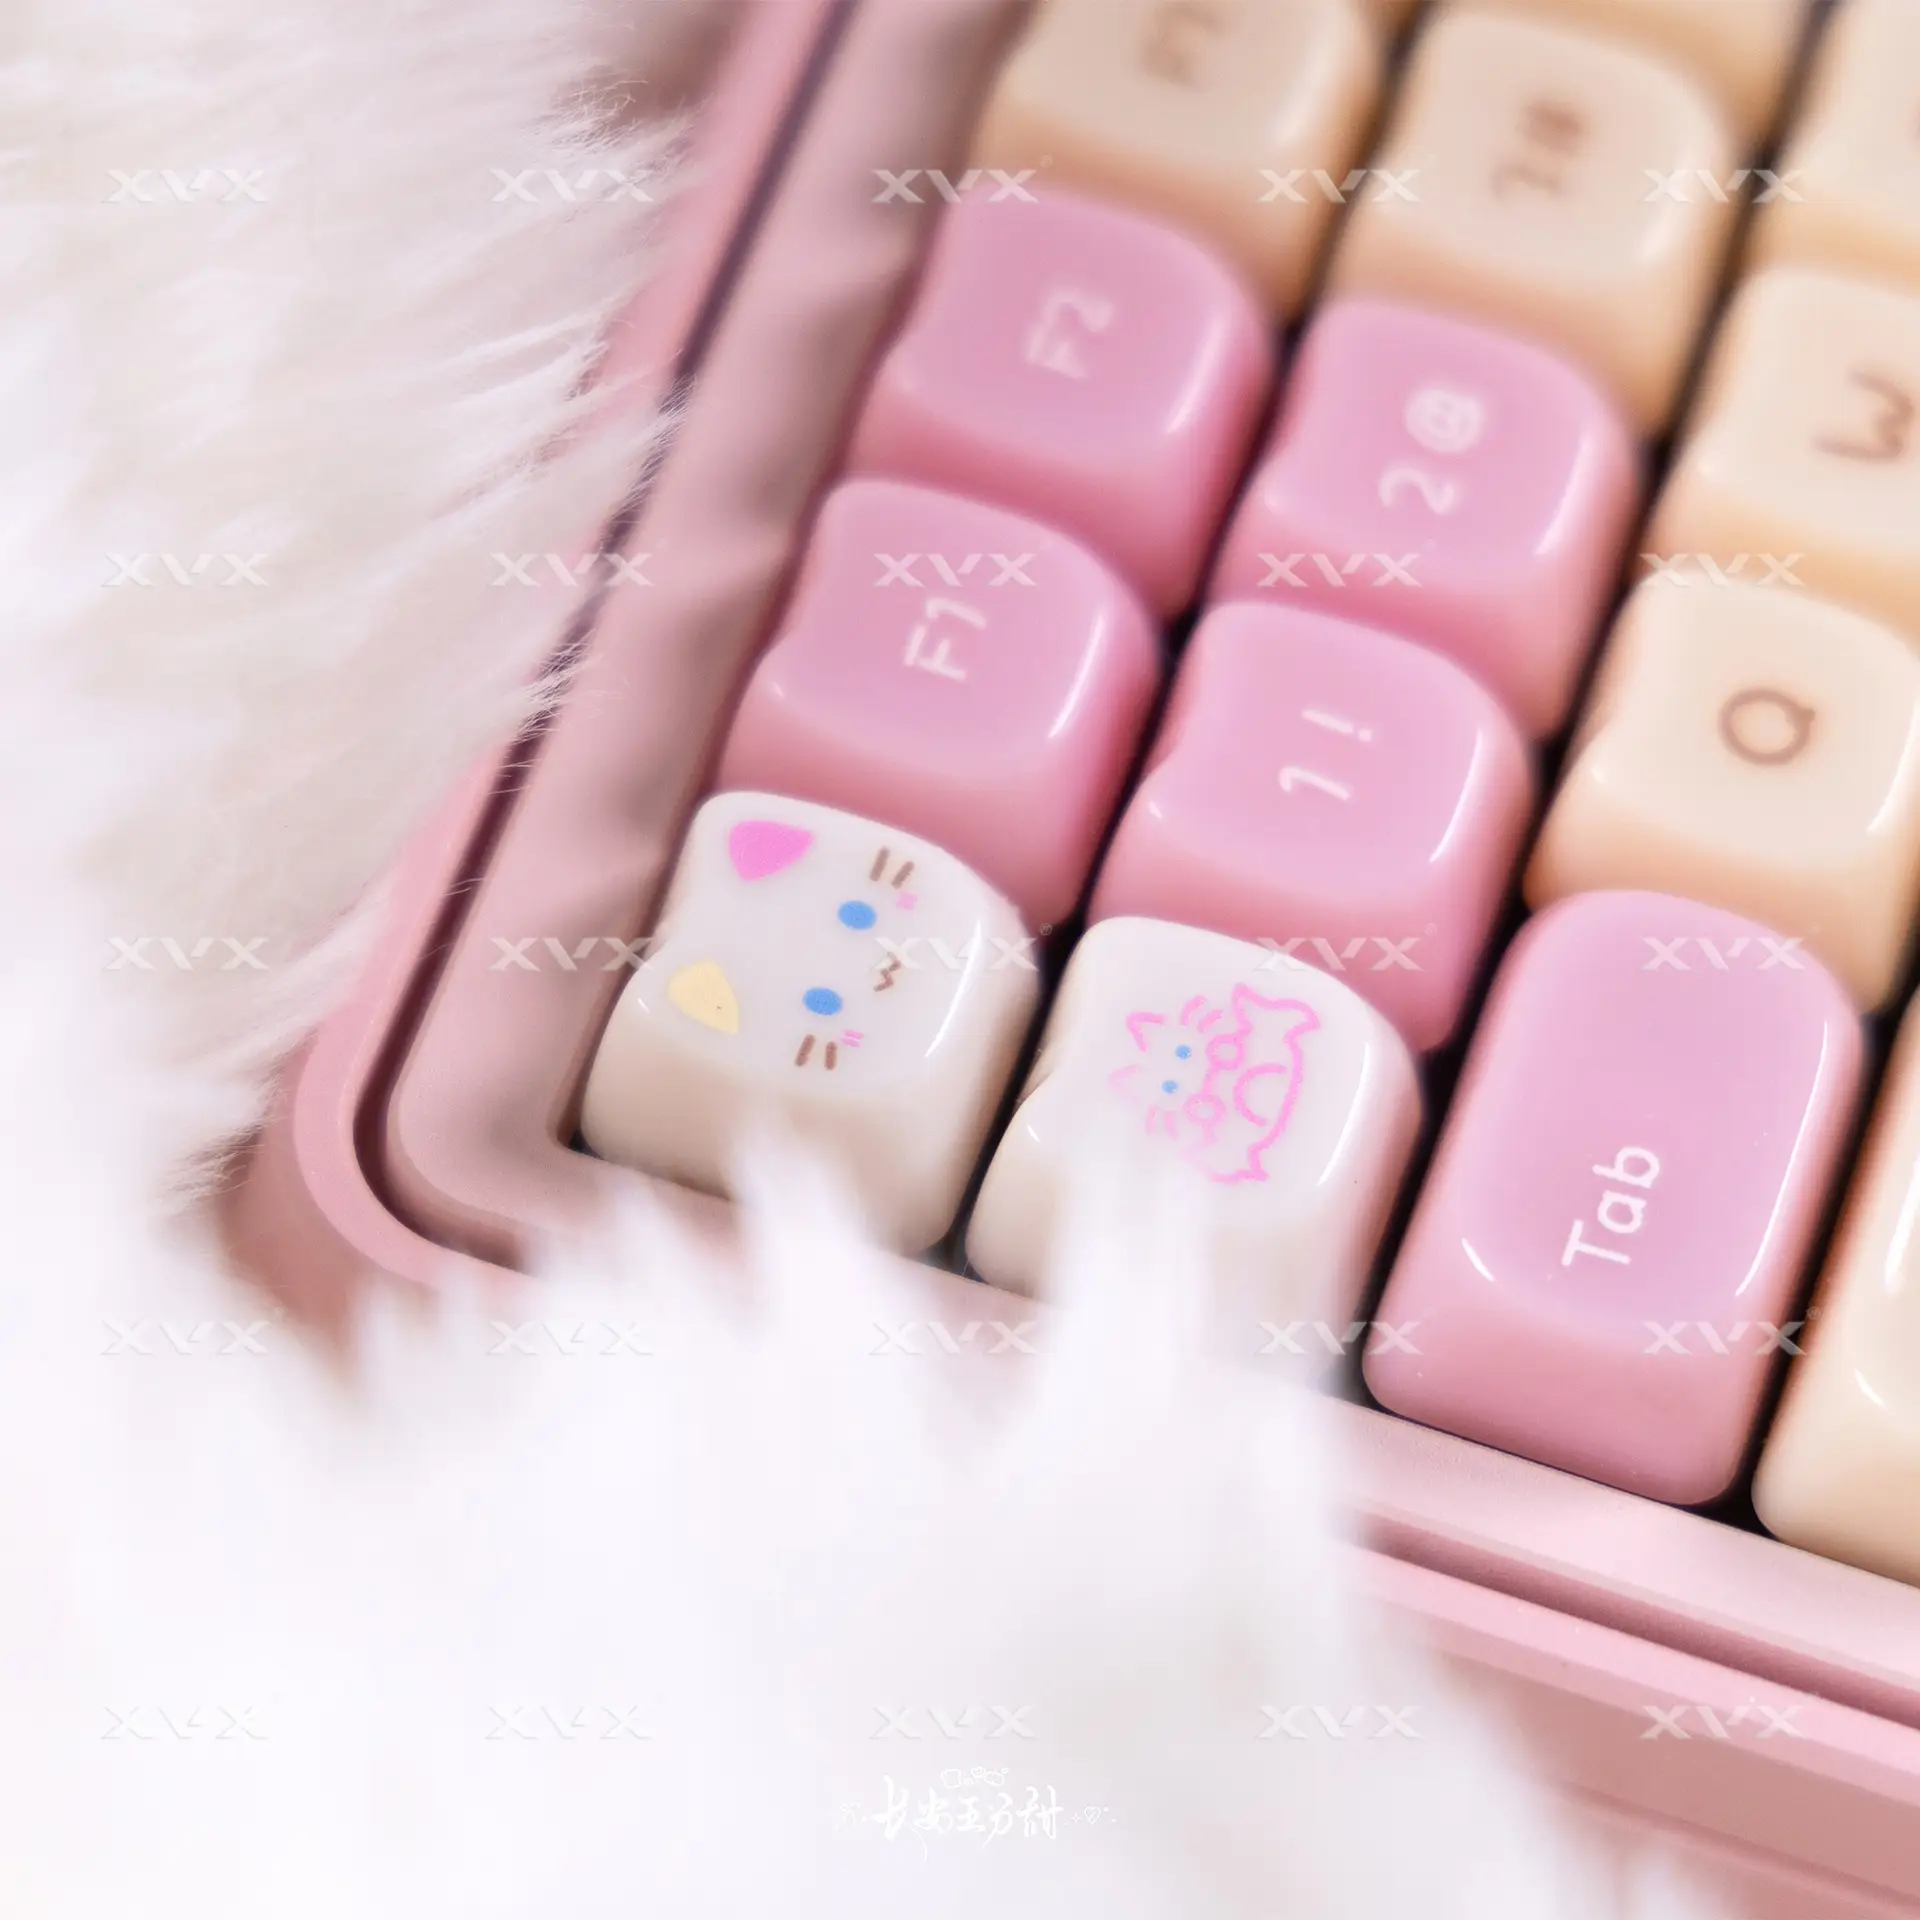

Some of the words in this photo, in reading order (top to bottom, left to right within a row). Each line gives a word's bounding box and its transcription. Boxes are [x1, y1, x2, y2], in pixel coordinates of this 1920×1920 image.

[1811, 369, 1914, 463] W
[1377, 467, 1455, 514] 2
[904, 599, 988, 681] F1
[1718, 687, 1816, 766] Q
[1560, 1145, 1660, 1266] Tab
